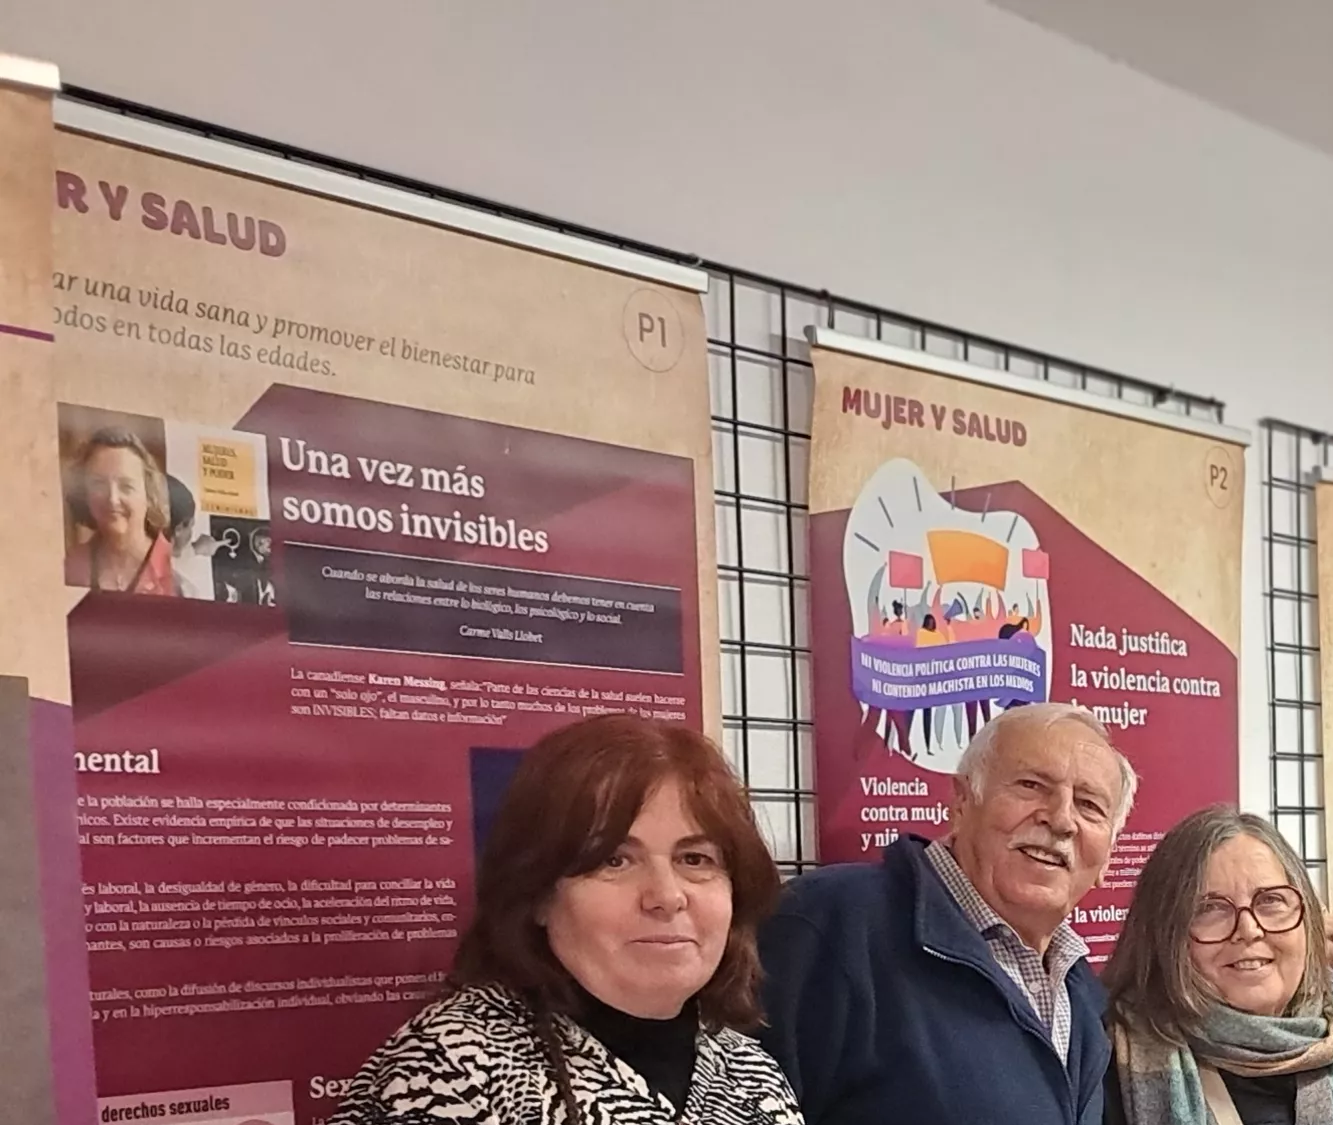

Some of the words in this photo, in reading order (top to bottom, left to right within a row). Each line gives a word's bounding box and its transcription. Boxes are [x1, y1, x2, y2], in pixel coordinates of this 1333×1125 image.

[98, 180, 129, 221] Y
[140, 192, 287, 257] SALUD
[84, 277, 131, 303] una
[138, 286, 189, 315] vida
[195, 301, 250, 327] sana
[252, 313, 268, 334] y
[272, 316, 375, 352] promover
[379, 337, 396, 358] el
[401, 339, 491, 375] bienestar
[493, 362, 536, 385] para
[638, 311, 667, 348] P1
[113, 318, 141, 340] en
[148, 323, 213, 353] todas
[219, 334, 251, 361] las
[257, 345, 336, 377] edades.
[842, 386, 924, 430] MUJER
[930, 403, 946, 431] Y
[952, 408, 1027, 447] SALUD
[279, 437, 351, 479] Una
[357, 457, 414, 488] vez
[420, 464, 485, 498] más
[1209, 463, 1229, 491] P2
[283, 496, 394, 533] somos
[400, 503, 549, 553] invisibles
[1070, 623, 1117, 651] Nada
[1119, 628, 1188, 657] justifica
[873, 658, 914, 677] VIOLENCIA
[914, 658, 954, 676] POLÍTICA
[956, 654, 992, 671] CONTRA
[993, 653, 1009, 668] LAS
[1009, 654, 1041, 678] MUJERES
[290, 667, 304, 680] La
[368, 673, 401, 686] Karen
[403, 675, 448, 692] Messing,
[871, 678, 882, 693] NI
[883, 682, 927, 698] CONTENIDO
[928, 677, 975, 695] MACHISTA
[976, 676, 988, 688] EN
[989, 675, 1005, 688] LOS
[1005, 674, 1034, 693] MEDIOS
[1070, 663, 1088, 688] la
[1091, 665, 1170, 693] violencia
[1173, 675, 1221, 697] contra
[291, 688, 311, 698] con
[313, 689, 328, 699] un
[291, 705, 311, 715] son
[1092, 701, 1148, 729] mujer
[860, 776, 929, 796] Violencia
[113, 813, 150, 827] Existe
[152, 814, 207, 827] evidencia
[259, 815, 273, 827] de
[861, 804, 909, 822] contra
[911, 802, 950, 825] muje
[93, 834, 115, 845] son
[117, 832, 165, 845] factores
[167, 835, 190, 848] que
[861, 833, 872, 852] y
[874, 828, 900, 847] niñ
[1074, 906, 1088, 923] la
[309, 1076, 354, 1098] Sex
[102, 1101, 166, 1123] derechos
[169, 1095, 230, 1117] sexuales
